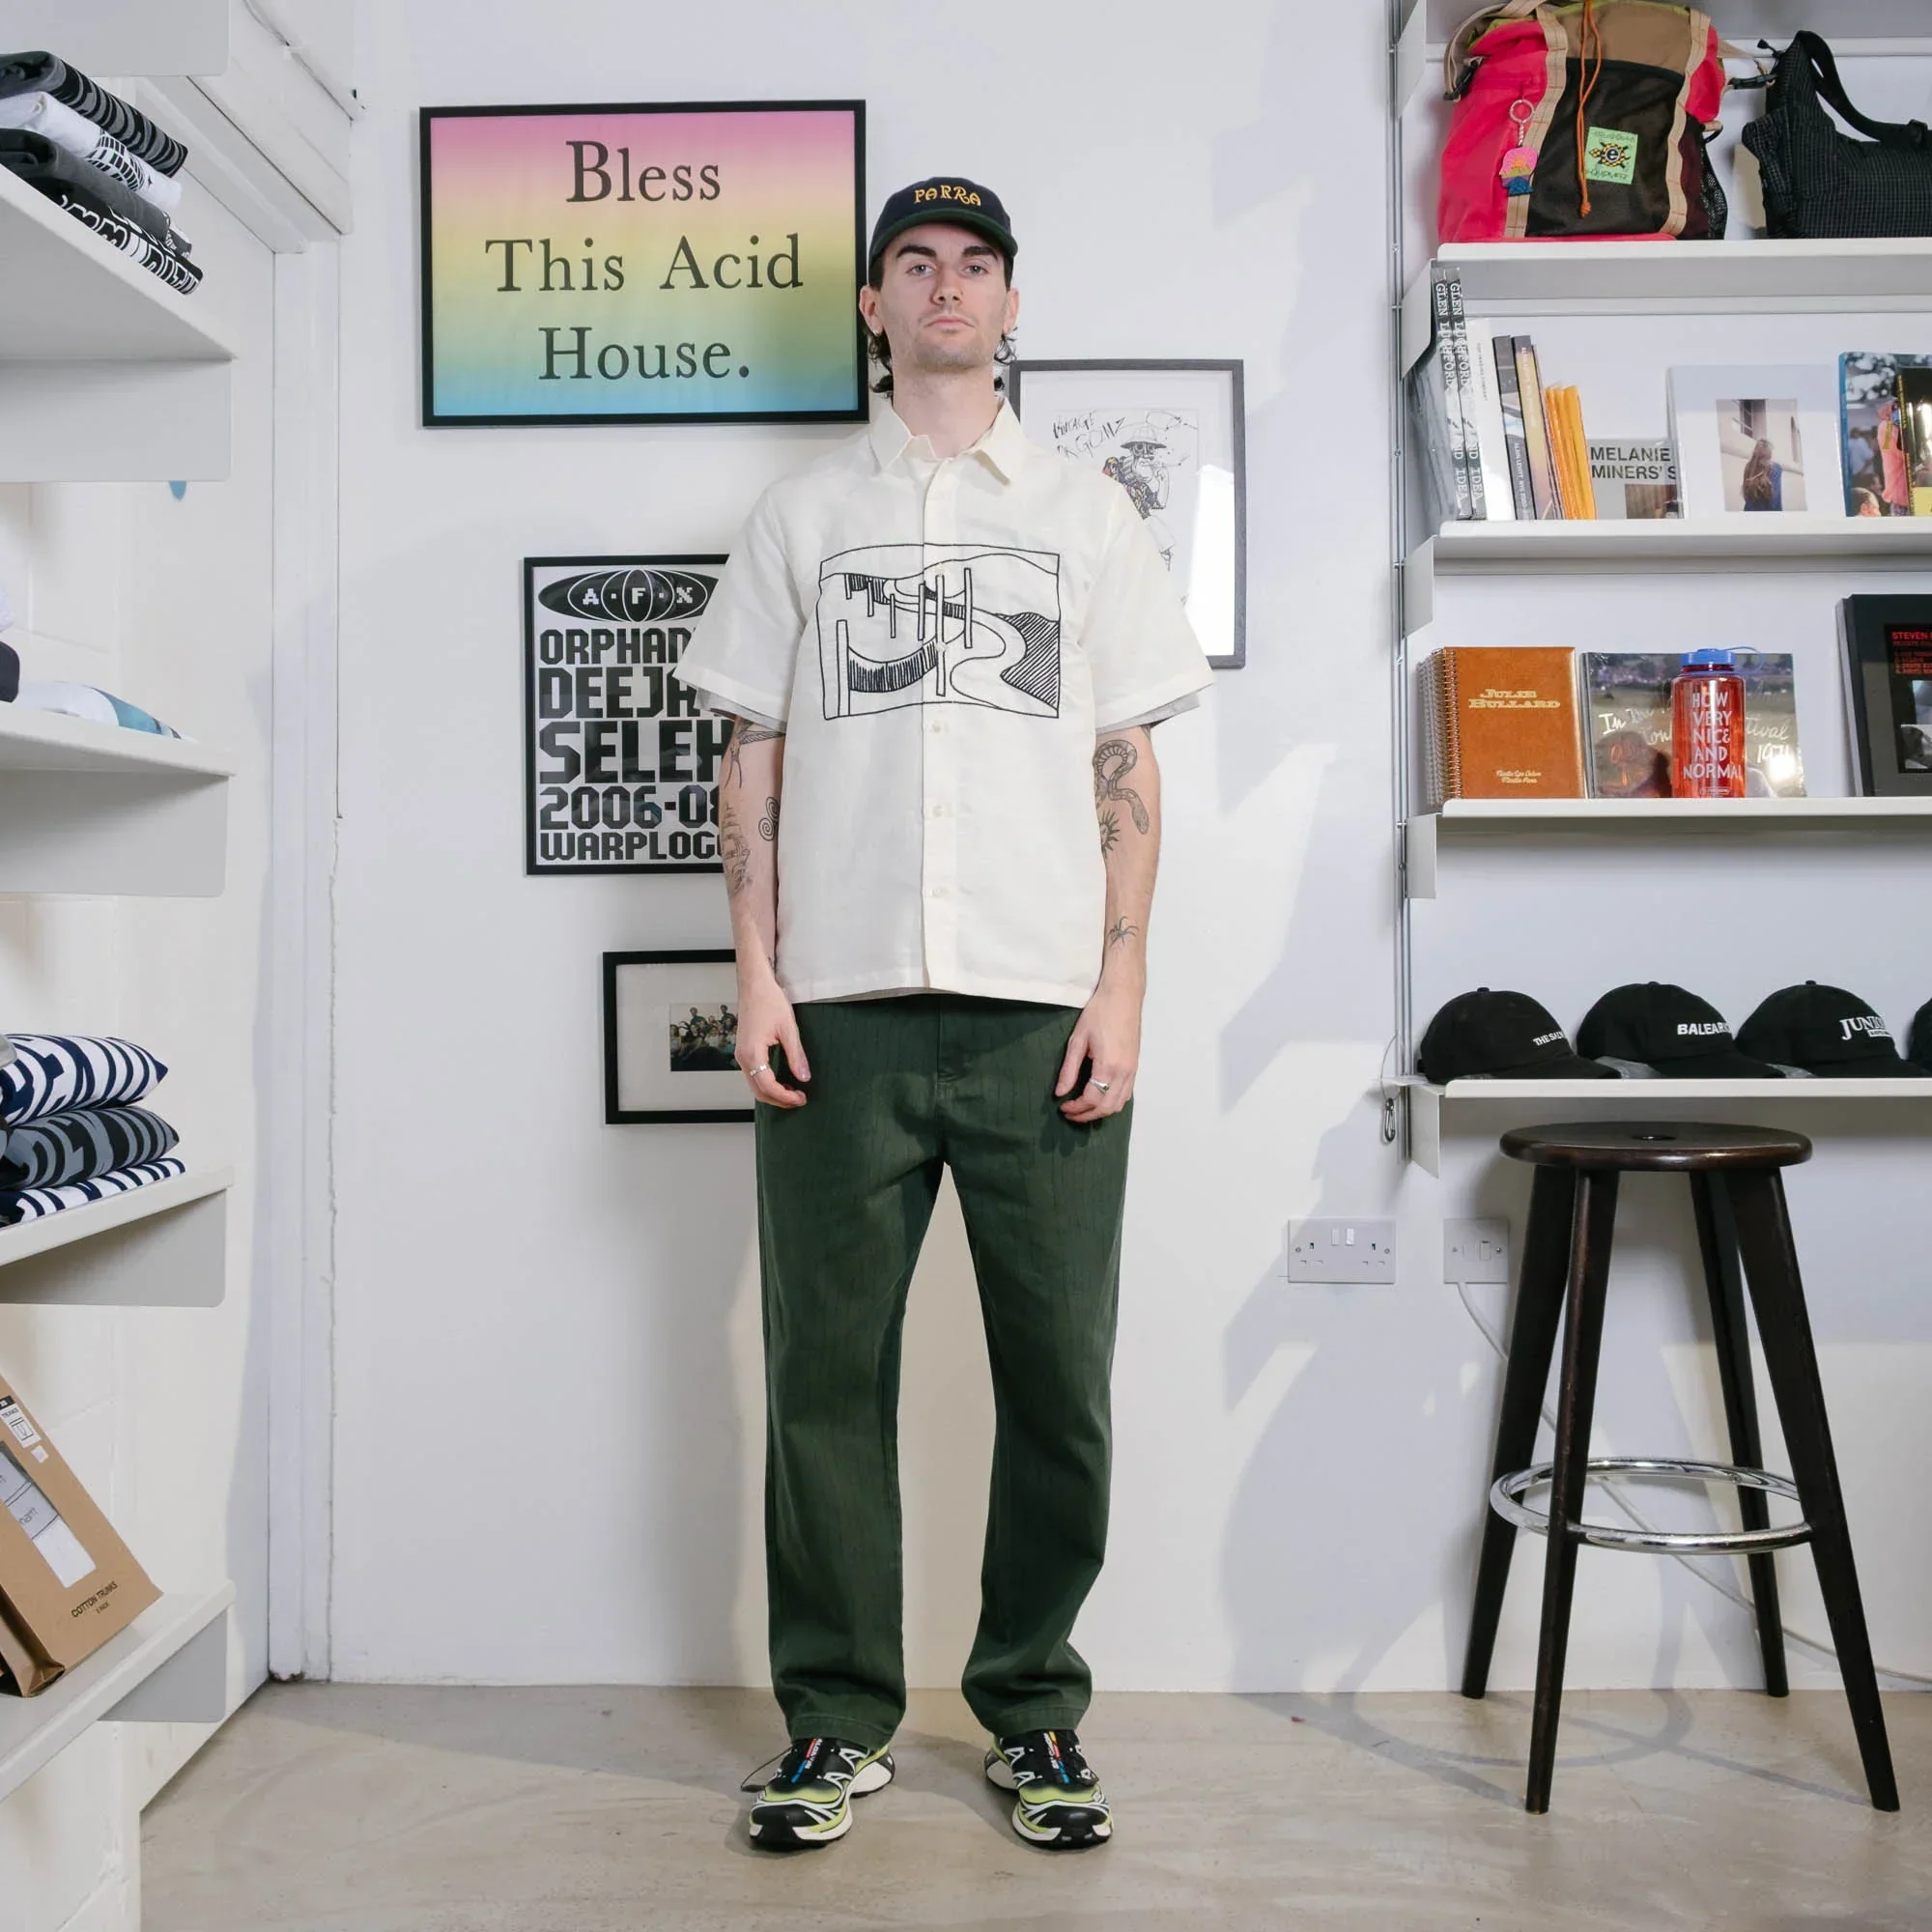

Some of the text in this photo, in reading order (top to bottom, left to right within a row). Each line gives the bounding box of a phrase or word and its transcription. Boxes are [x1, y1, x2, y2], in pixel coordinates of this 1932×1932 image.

[565, 139, 722, 203] Bless
[913, 185, 981, 206] PARRA
[485, 233, 804, 292] This Acid
[538, 326, 750, 380] House.
[1590, 446, 1671, 462] MELANIE
[1591, 465, 1662, 480] MINERS'
[540, 628, 696, 665] ORPHAN
[539, 667, 701, 719] DEEJA
[1692, 691, 1728, 708] HOW
[1692, 710, 1732, 726] VERY
[1692, 727, 1731, 744] NICE
[1694, 746, 1728, 761] AND
[540, 831, 724, 860] WARPLOG
